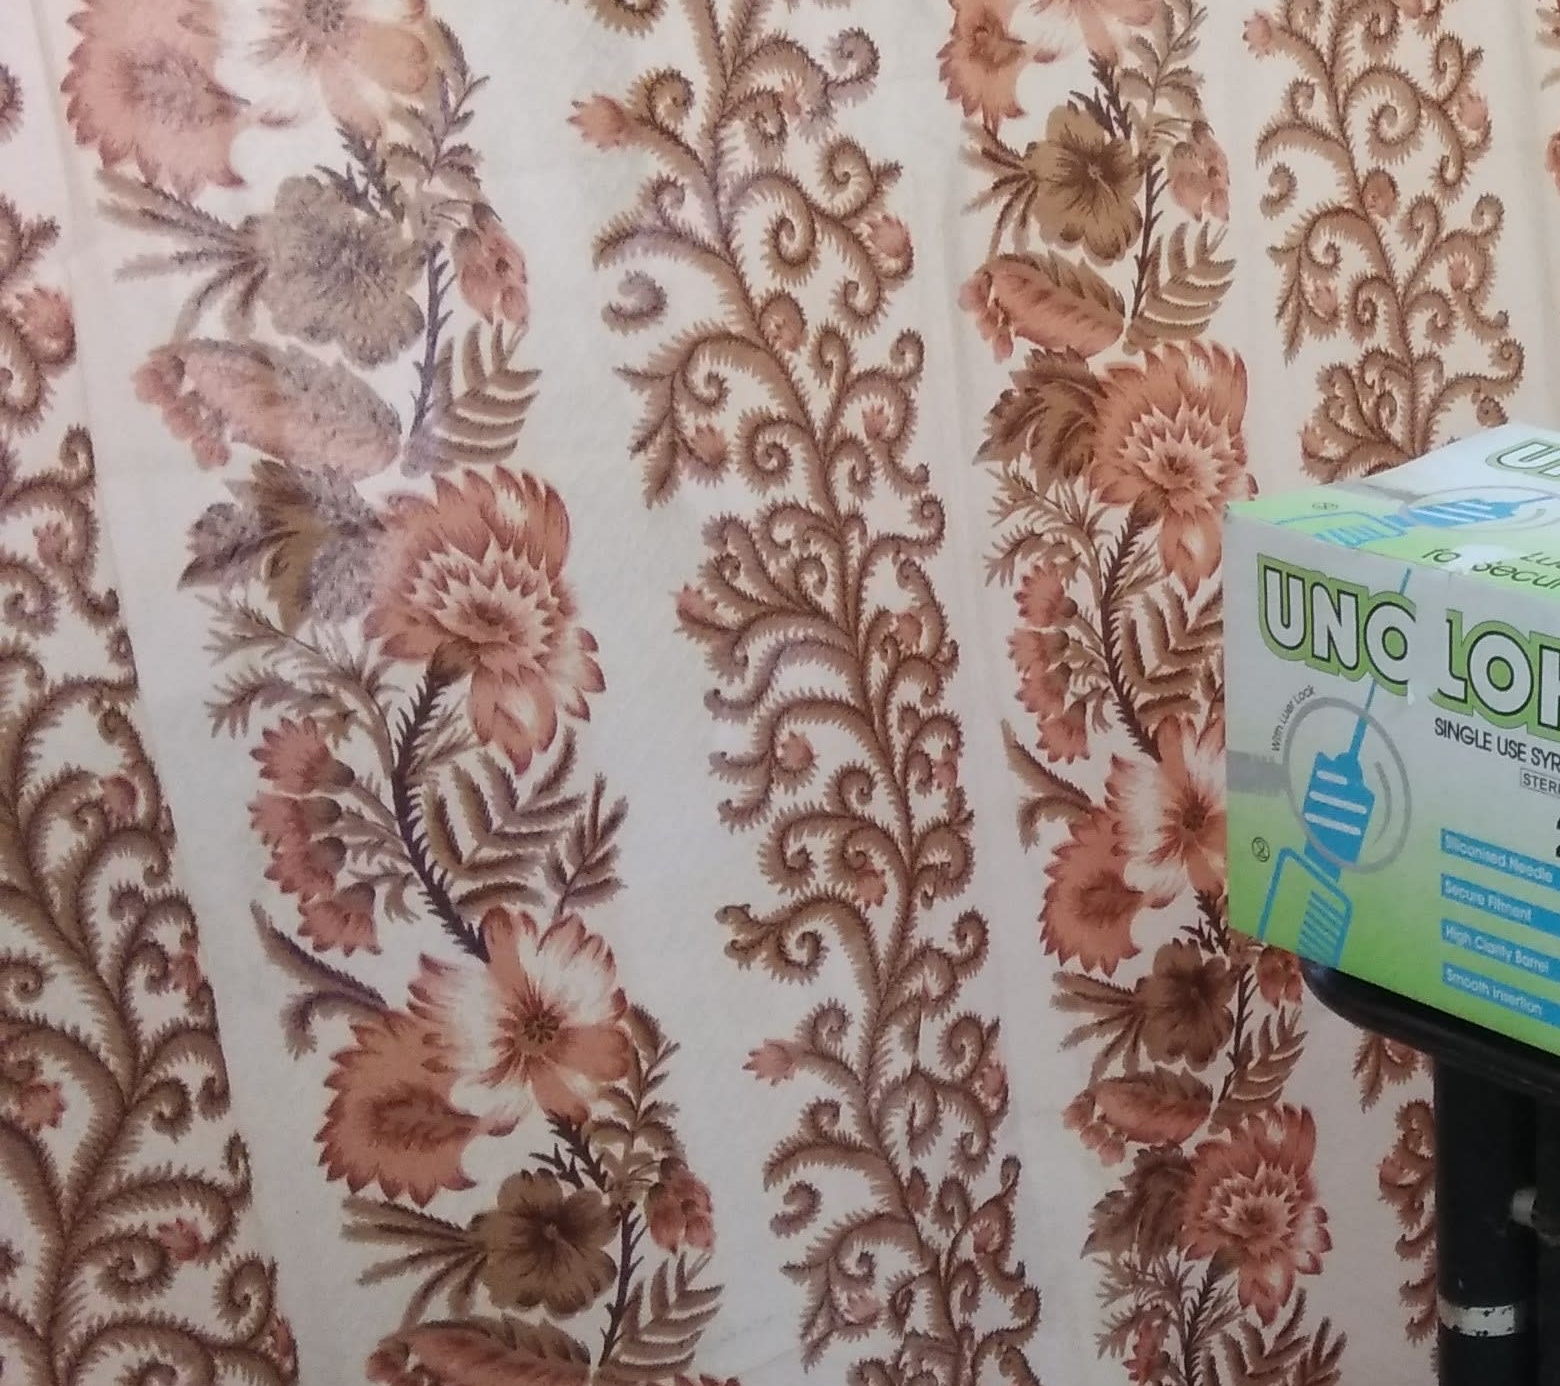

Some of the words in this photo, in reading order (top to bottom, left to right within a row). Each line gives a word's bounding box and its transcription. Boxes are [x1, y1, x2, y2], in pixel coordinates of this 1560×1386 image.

[1434, 717, 1493, 752] SINGLE
[1496, 736, 1527, 763] USE
[1445, 924, 1472, 946] High
[1445, 968, 1490, 997] Smooth
